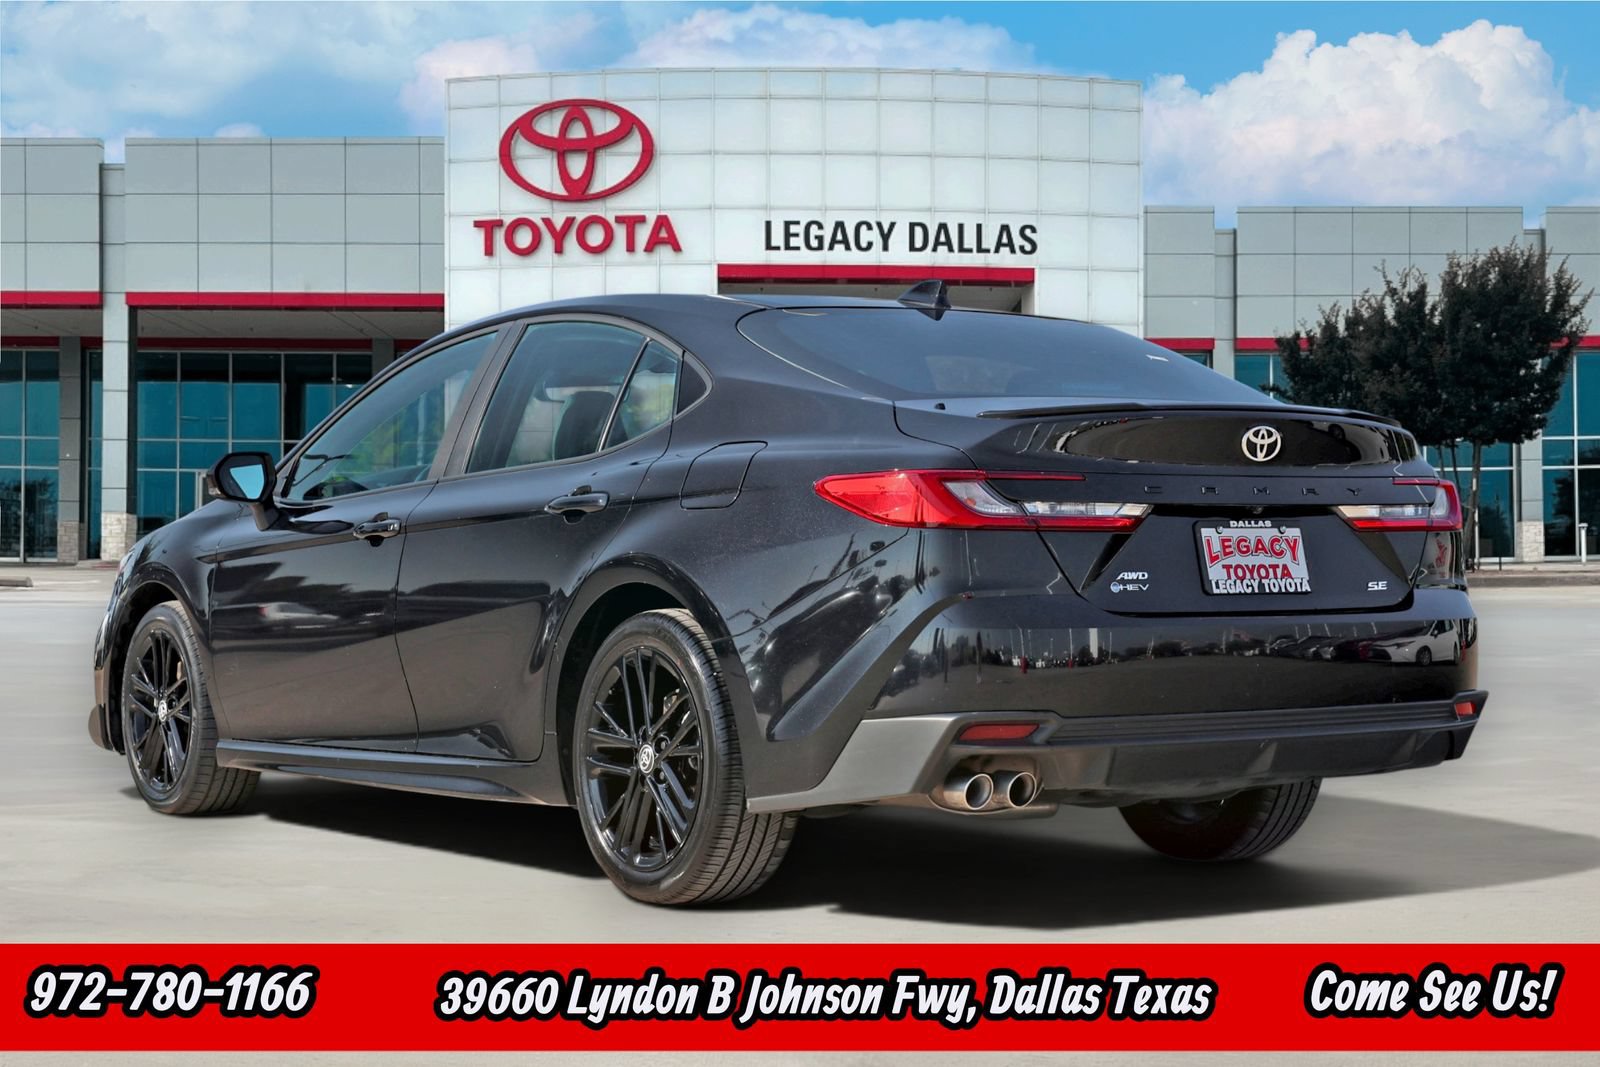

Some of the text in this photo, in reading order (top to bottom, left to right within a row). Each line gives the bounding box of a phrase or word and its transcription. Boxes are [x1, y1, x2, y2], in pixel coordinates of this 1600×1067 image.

[473, 214, 682, 257] TOYOTA
[764, 220, 1038, 256] LEGACY DALLAS
[1144, 485, 1362, 496] CAMRY
[1229, 520, 1272, 528] DALLAS
[1204, 535, 1300, 568] LEGACY
[1115, 571, 1149, 580] AWD
[1221, 563, 1293, 581] TOYOTA
[1211, 576, 1312, 594] LEGACY TOYOTA
[1367, 580, 1388, 591] SE
